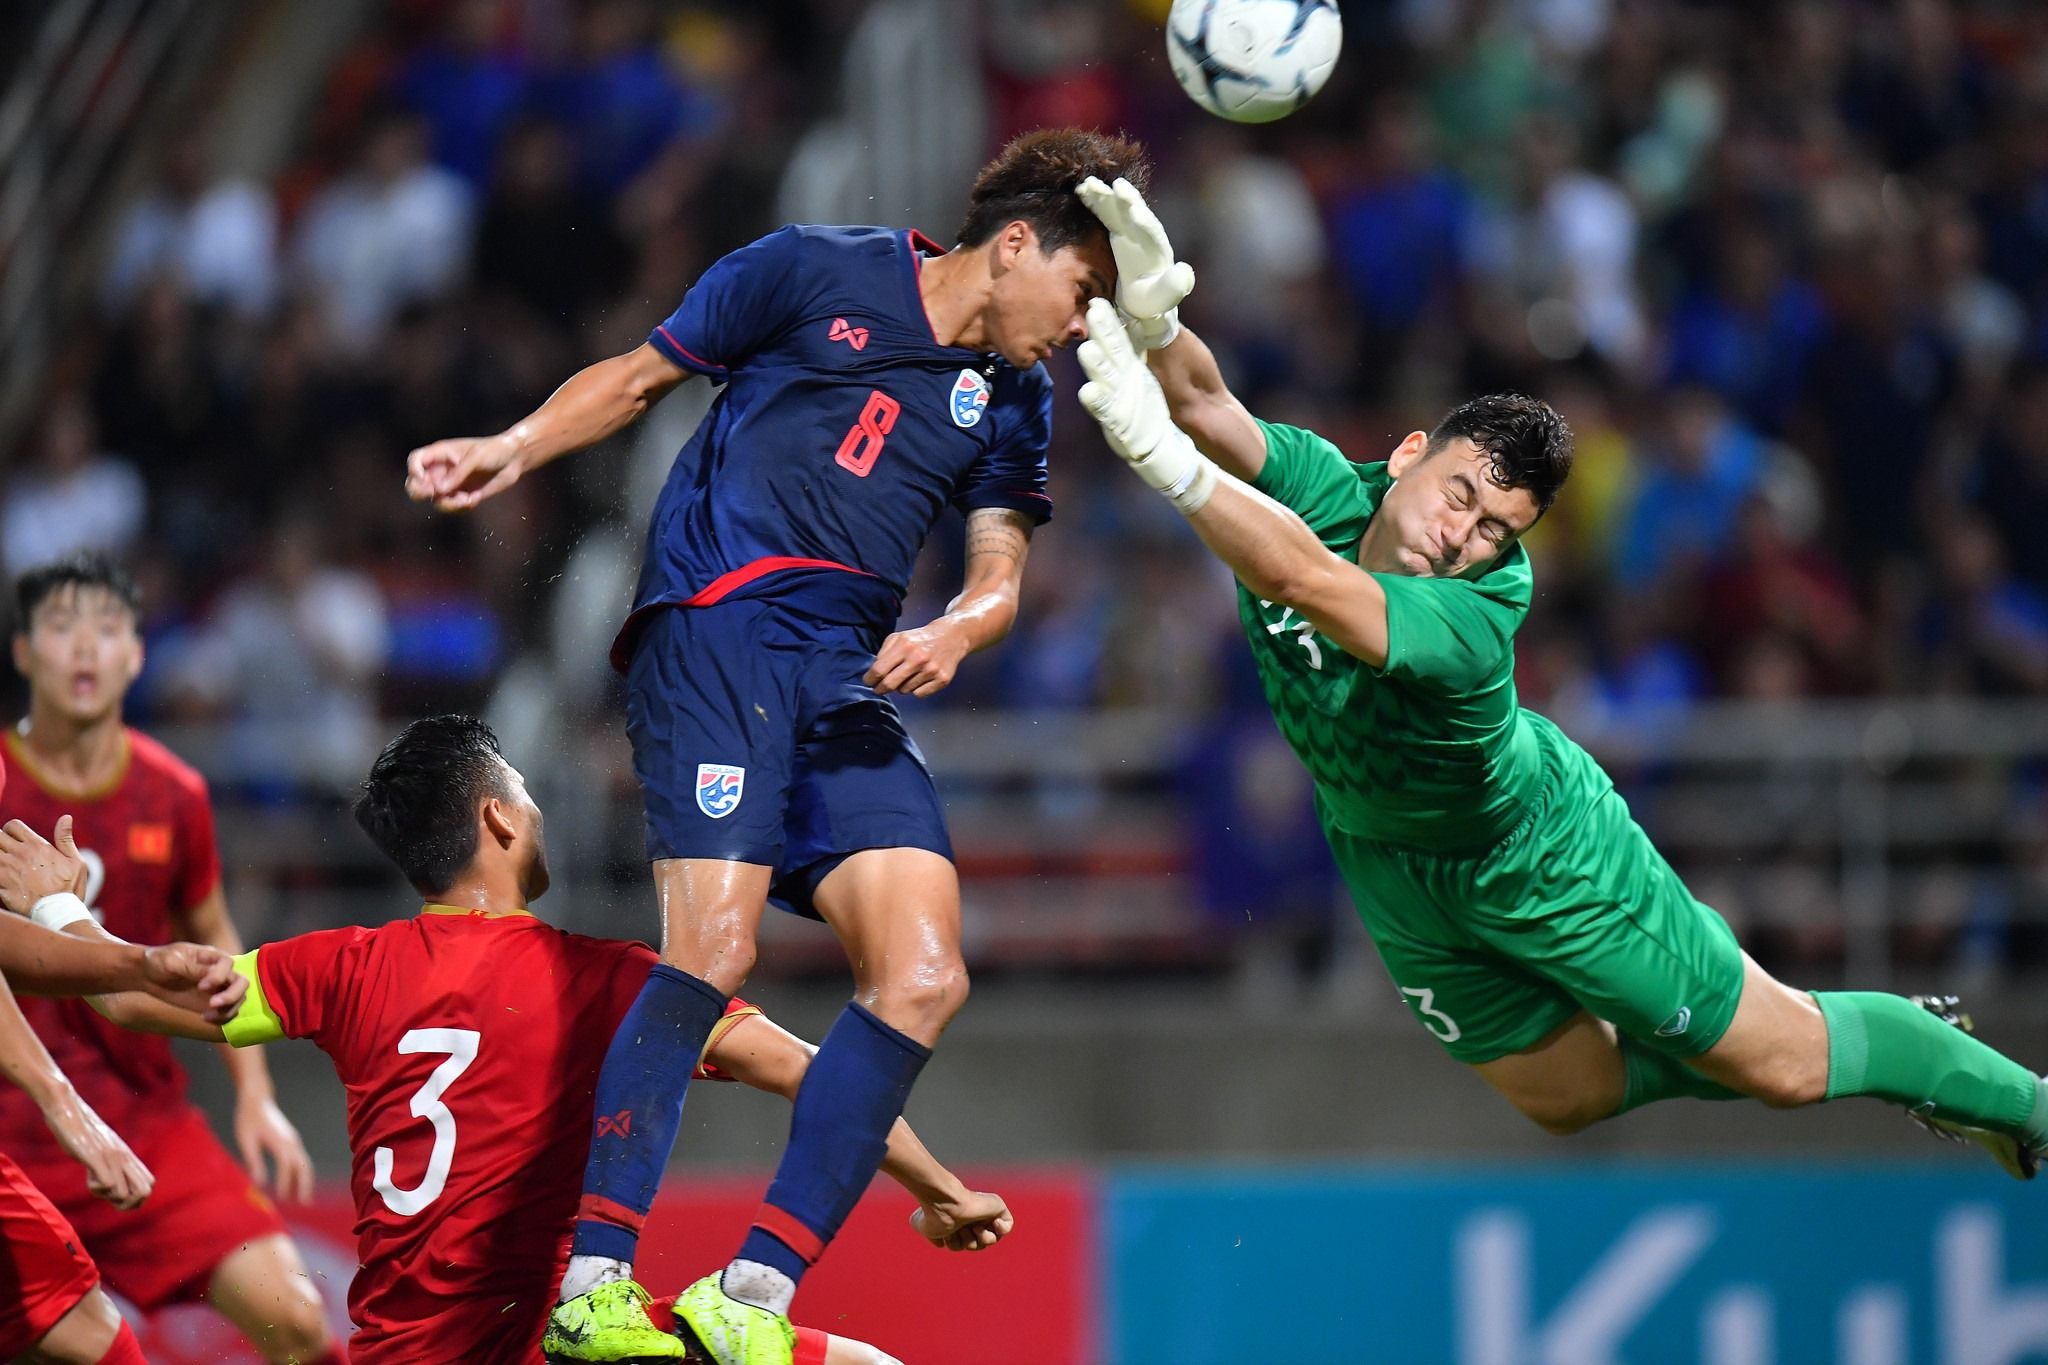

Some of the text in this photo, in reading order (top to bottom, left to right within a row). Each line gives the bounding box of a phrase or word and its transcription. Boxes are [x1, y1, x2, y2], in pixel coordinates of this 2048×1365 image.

[834, 390, 901, 478] 8
[1401, 986, 1461, 1042] 3
[372, 1027, 481, 1216] 3
